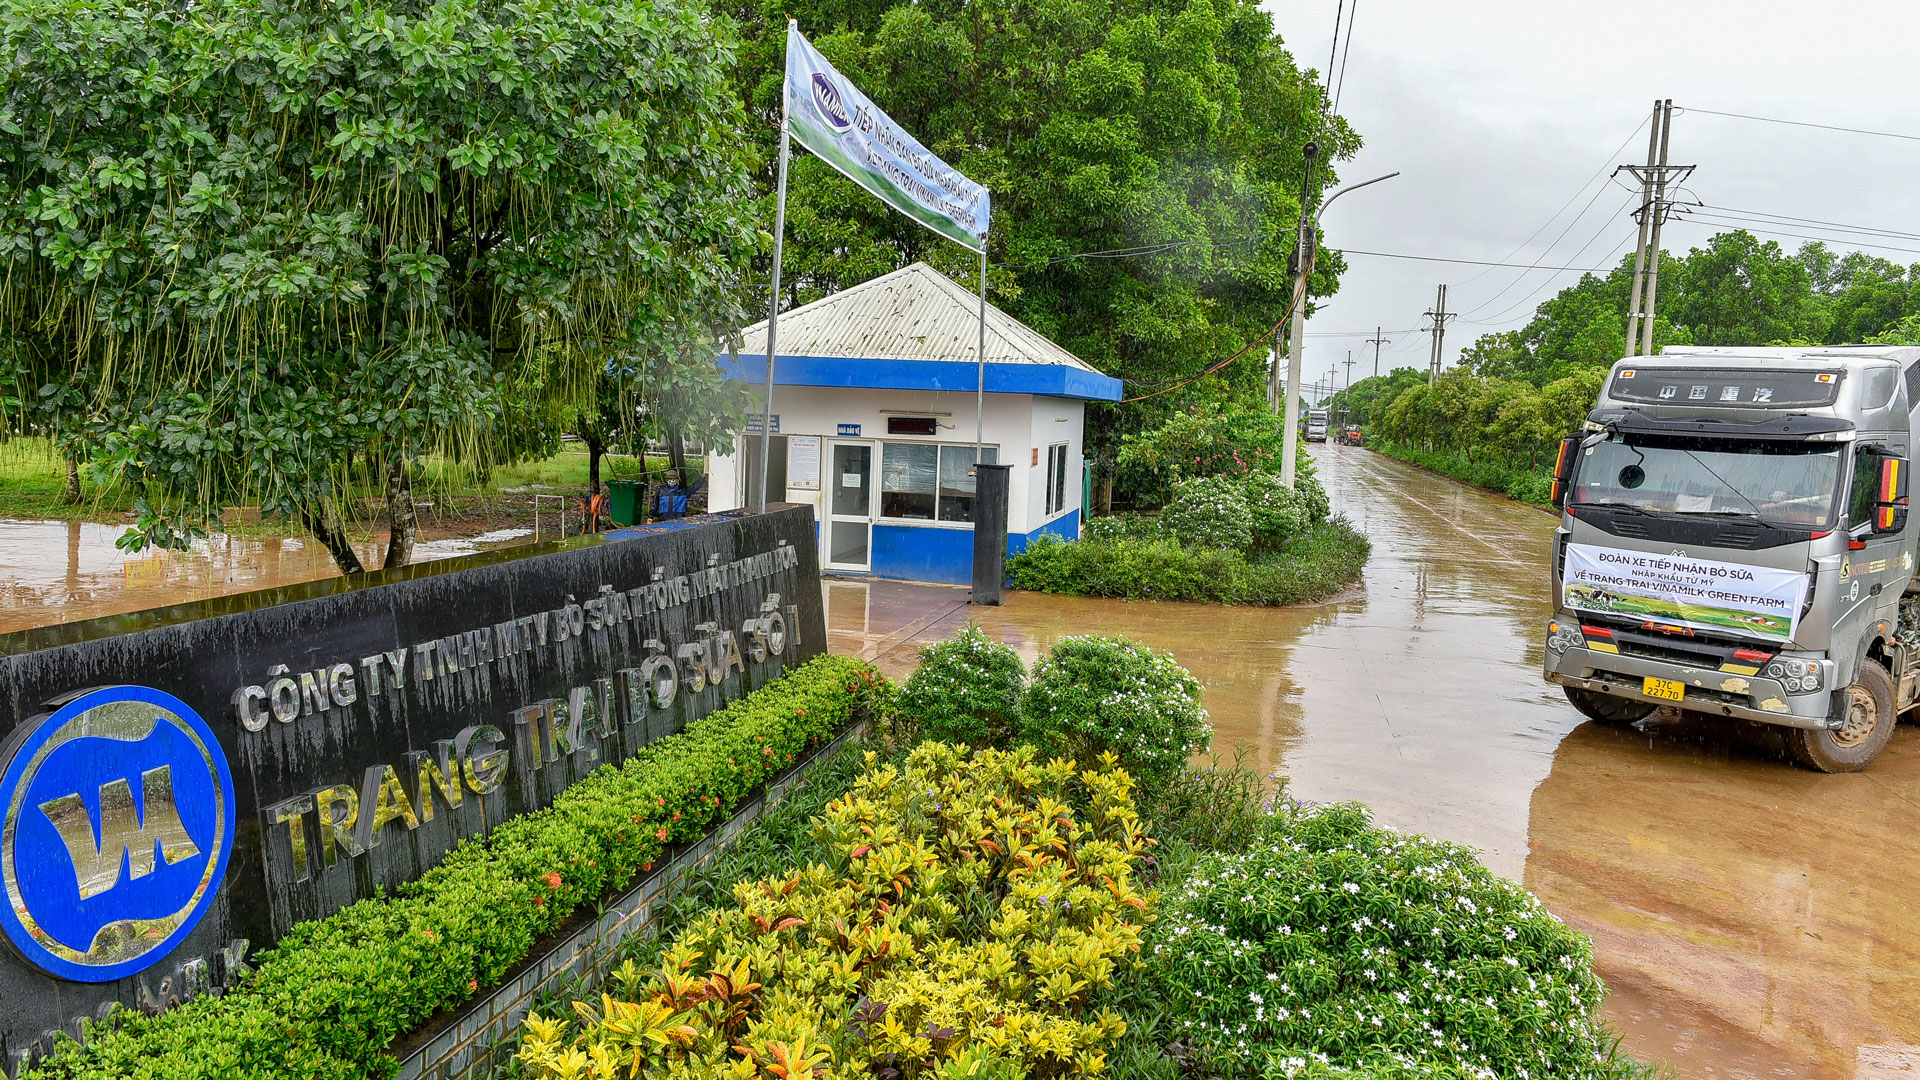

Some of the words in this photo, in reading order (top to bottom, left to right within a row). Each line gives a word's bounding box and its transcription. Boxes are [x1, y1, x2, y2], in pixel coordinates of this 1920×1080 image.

[853, 104, 874, 135] TIẾP
[875, 121, 896, 154] NHẬN
[1599, 551, 1630, 565] ĐOÀN
[1632, 557, 1646, 568] XE
[1648, 557, 1672, 570] TIẾP
[1673, 562, 1707, 576] NHẬN
[1709, 566, 1728, 578] BÒ
[1729, 568, 1755, 582] SỮA
[1631, 569, 1656, 580] NHẬP
[1657, 572, 1683, 583] KHẨU
[1685, 573, 1699, 585] TỪ
[1700, 577, 1715, 588] MỸ
[1573, 568, 1587, 580] VỀ
[1588, 571, 1624, 586] TRANG
[1626, 577, 1650, 591] TRẠI
[1652, 581, 1706, 598] VINAMILK
[1707, 590, 1748, 604] GREEN
[1750, 594, 1786, 610] FARM
[235, 664, 357, 732] CÔNG
[359, 648, 408, 696] TY
[412, 626, 493, 680] TNHH
[493, 611, 549, 659] MTV
[554, 594, 584, 642] BÒ
[584, 584, 632, 631] SỮA
[627, 566, 690, 617] THỐNG
[690, 553, 730, 599] NHẤT
[730, 551, 774, 587] THANH
[774, 539, 799, 573] HÓA
[1647, 687, 1679, 700] 227.70
[1655, 679, 1673, 690] 37C
[262, 724, 509, 883] TRANG
[511, 678, 618, 770] TRẠI
[616, 639, 678, 724] BÒ
[677, 622, 745, 693] SỮA
[743, 593, 786, 664] SỐ
